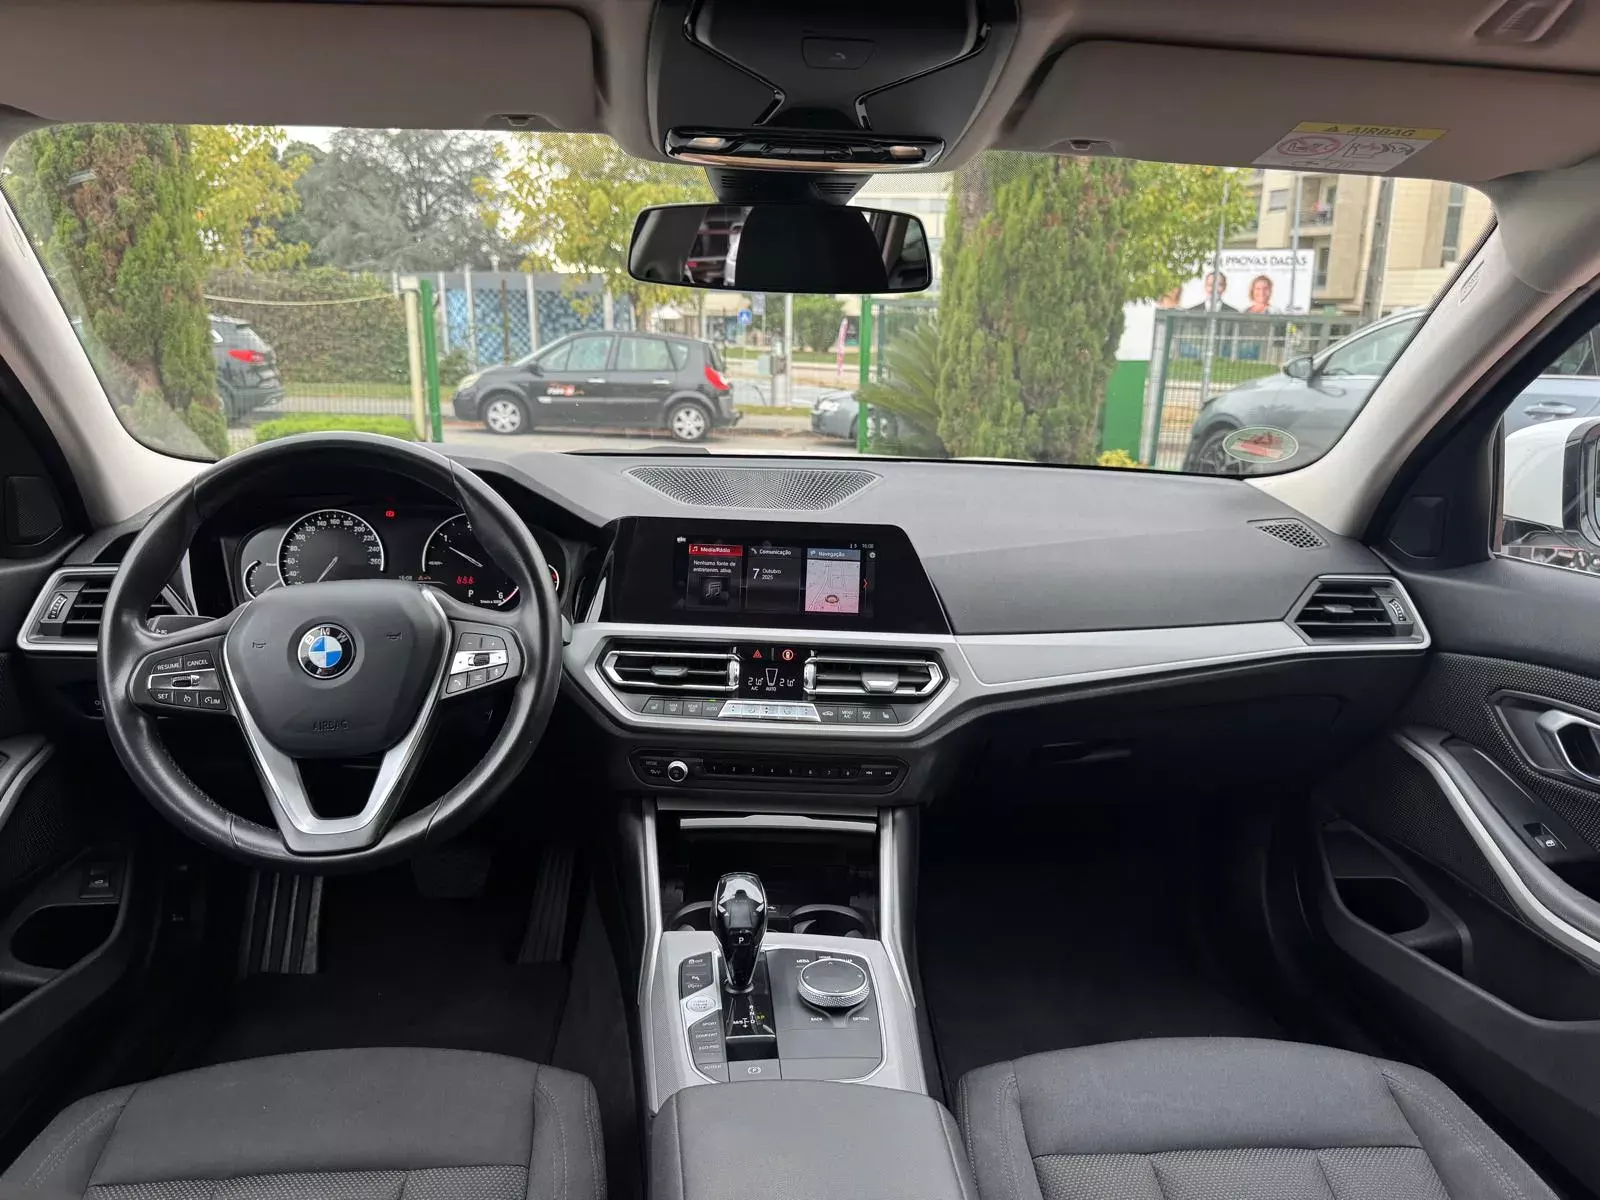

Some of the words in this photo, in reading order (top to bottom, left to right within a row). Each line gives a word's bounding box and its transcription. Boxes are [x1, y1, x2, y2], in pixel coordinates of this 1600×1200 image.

[1347, 127, 1416, 137] AIRBAG
[752, 568, 760, 580] 7
[468, 590, 475, 598] P
[305, 628, 348, 645] BMW
[157, 662, 181, 671] RESUME
[187, 659, 208, 667] CANCEL
